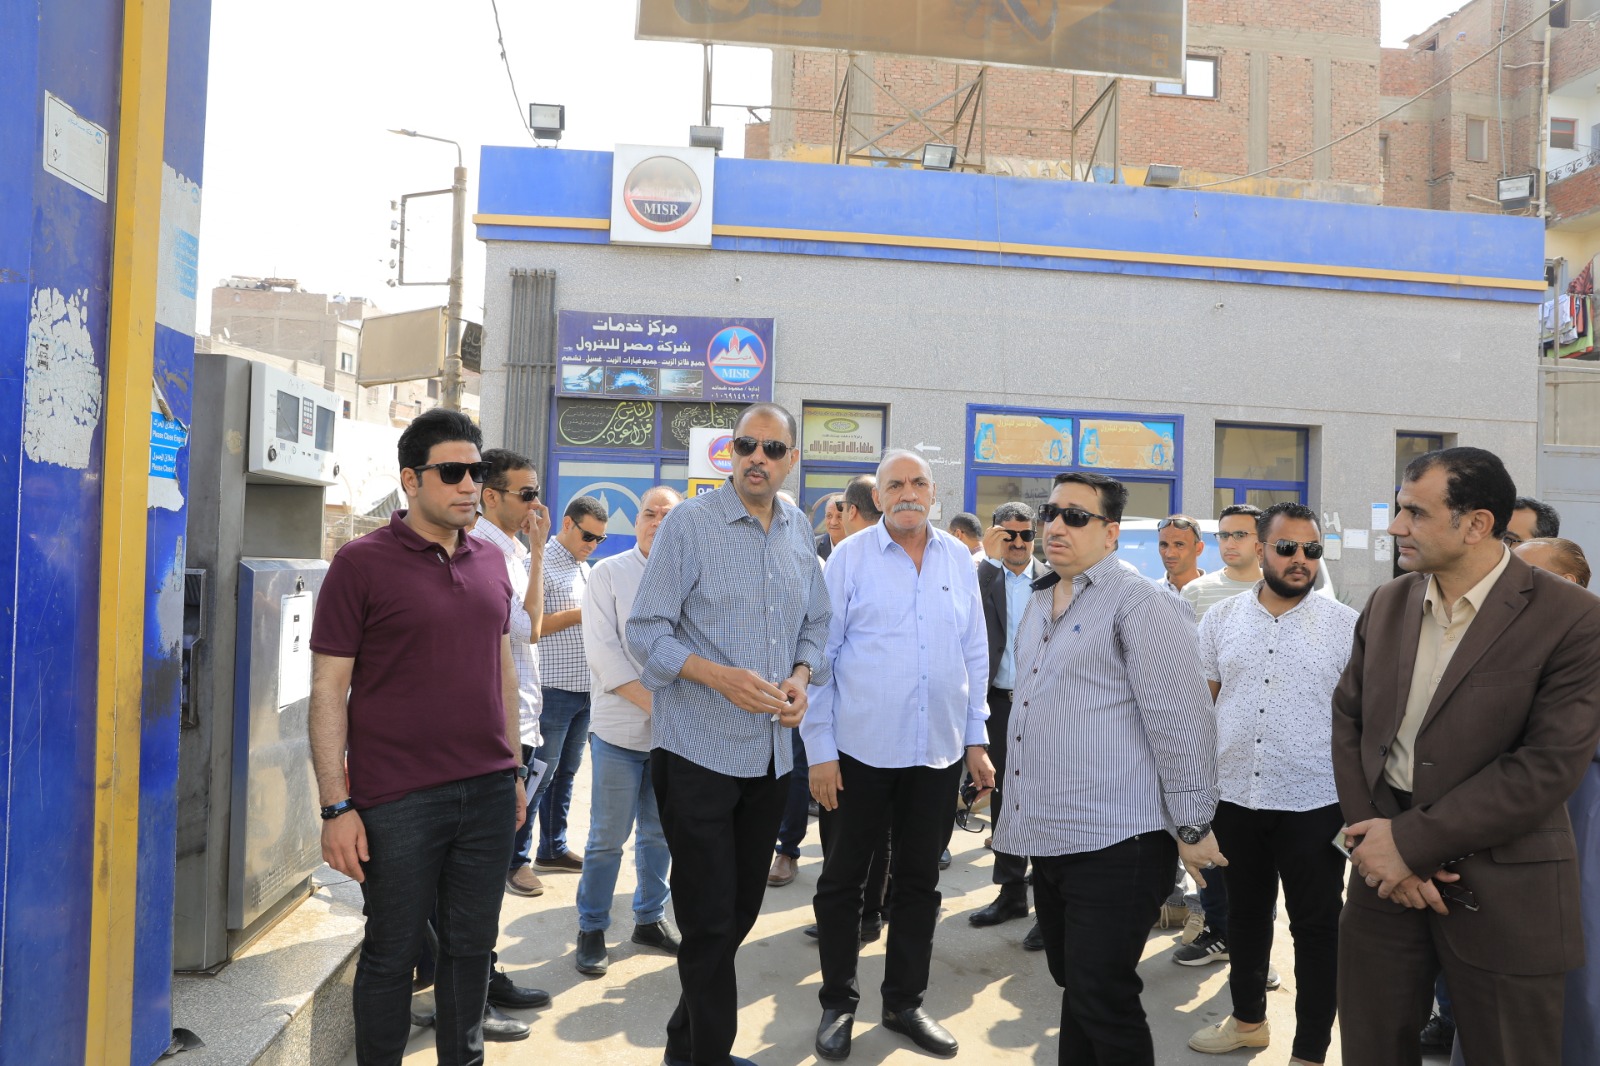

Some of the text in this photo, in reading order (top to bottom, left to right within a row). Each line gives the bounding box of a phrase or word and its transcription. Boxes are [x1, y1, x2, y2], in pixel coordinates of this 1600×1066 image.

[644, 203, 679, 216] MISR
[592, 317, 678, 336] مركز خدمات
[576, 336, 691, 354] شركة مصر للبترول
[586, 354, 602, 363] غسيل
[722, 368, 750, 378] MISR
[152, 430, 164, 439] Please
[164, 432, 174, 441] Close
[152, 463, 163, 471] Please
